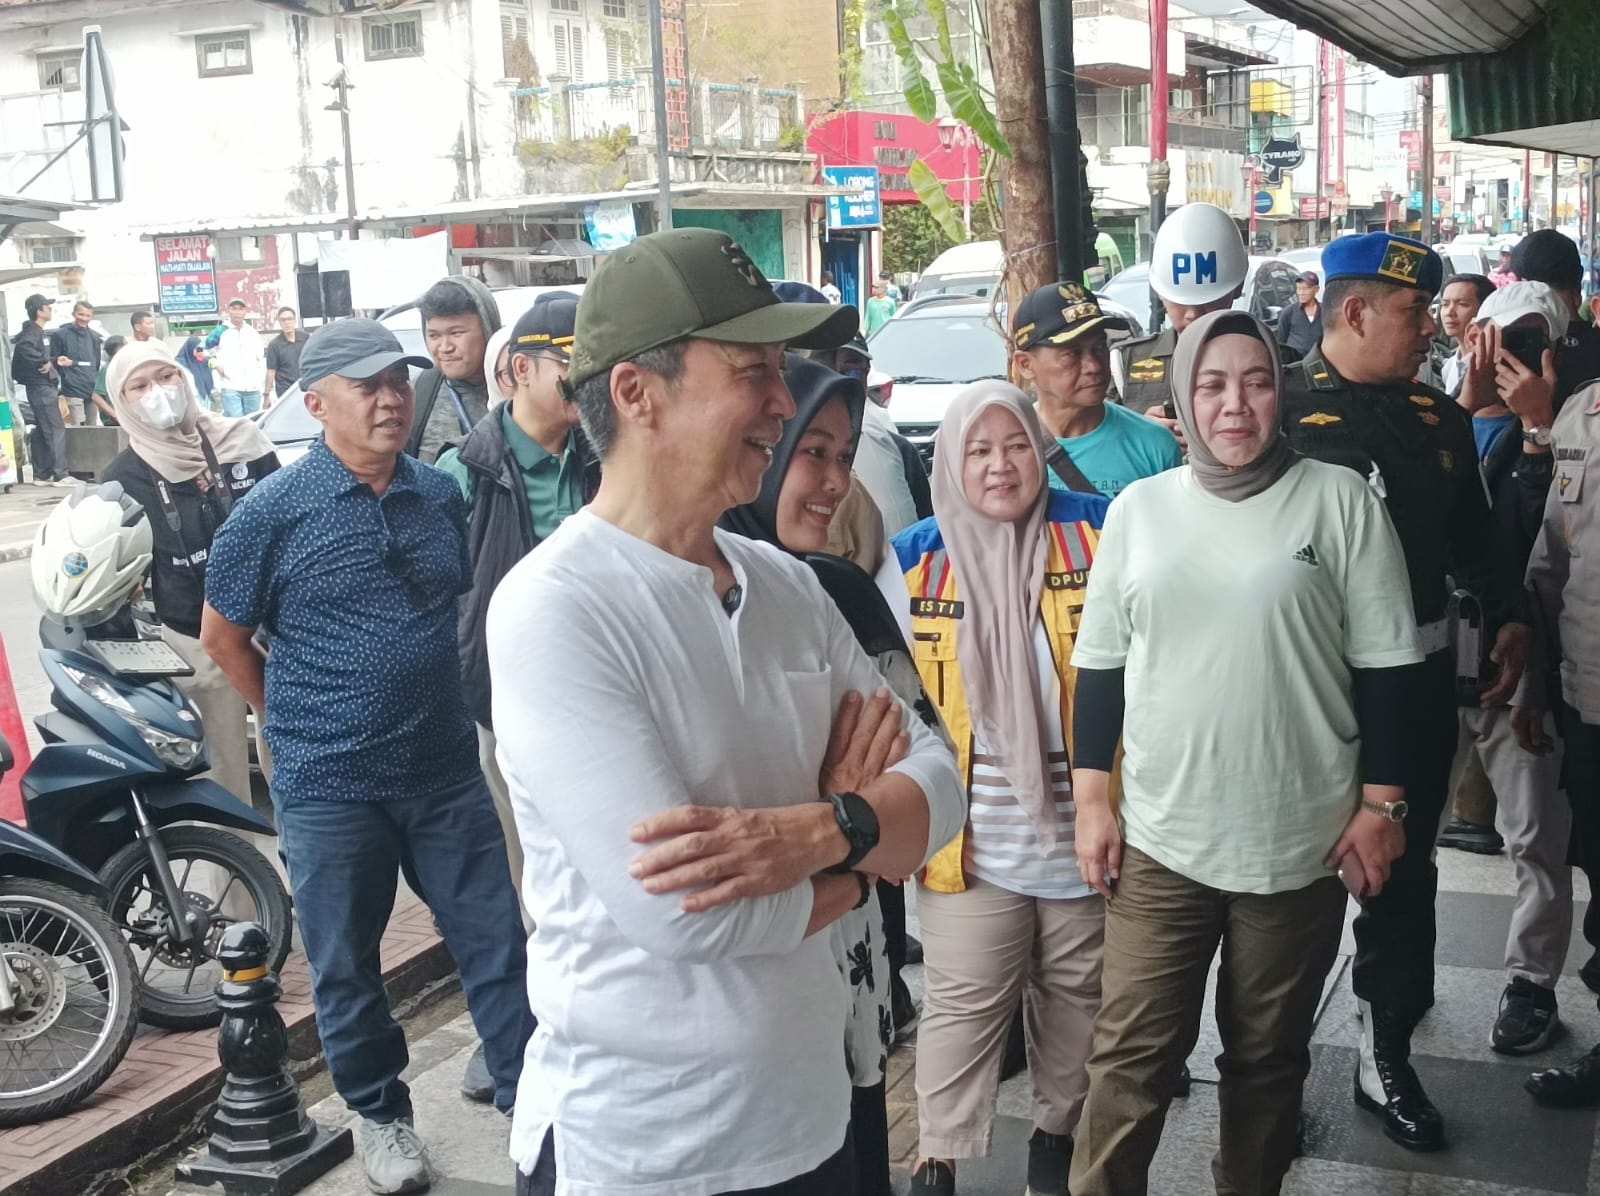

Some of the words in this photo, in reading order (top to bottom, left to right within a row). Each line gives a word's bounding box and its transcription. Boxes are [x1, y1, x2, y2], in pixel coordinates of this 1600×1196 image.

[159, 238, 208, 251] SELAMAT
[167, 249, 201, 262] JALAN
[1172, 251, 1217, 285] PM
[1051, 572, 1089, 587] DPU
[920, 600, 954, 615] ESTI
[87, 749, 127, 769] HONDA
